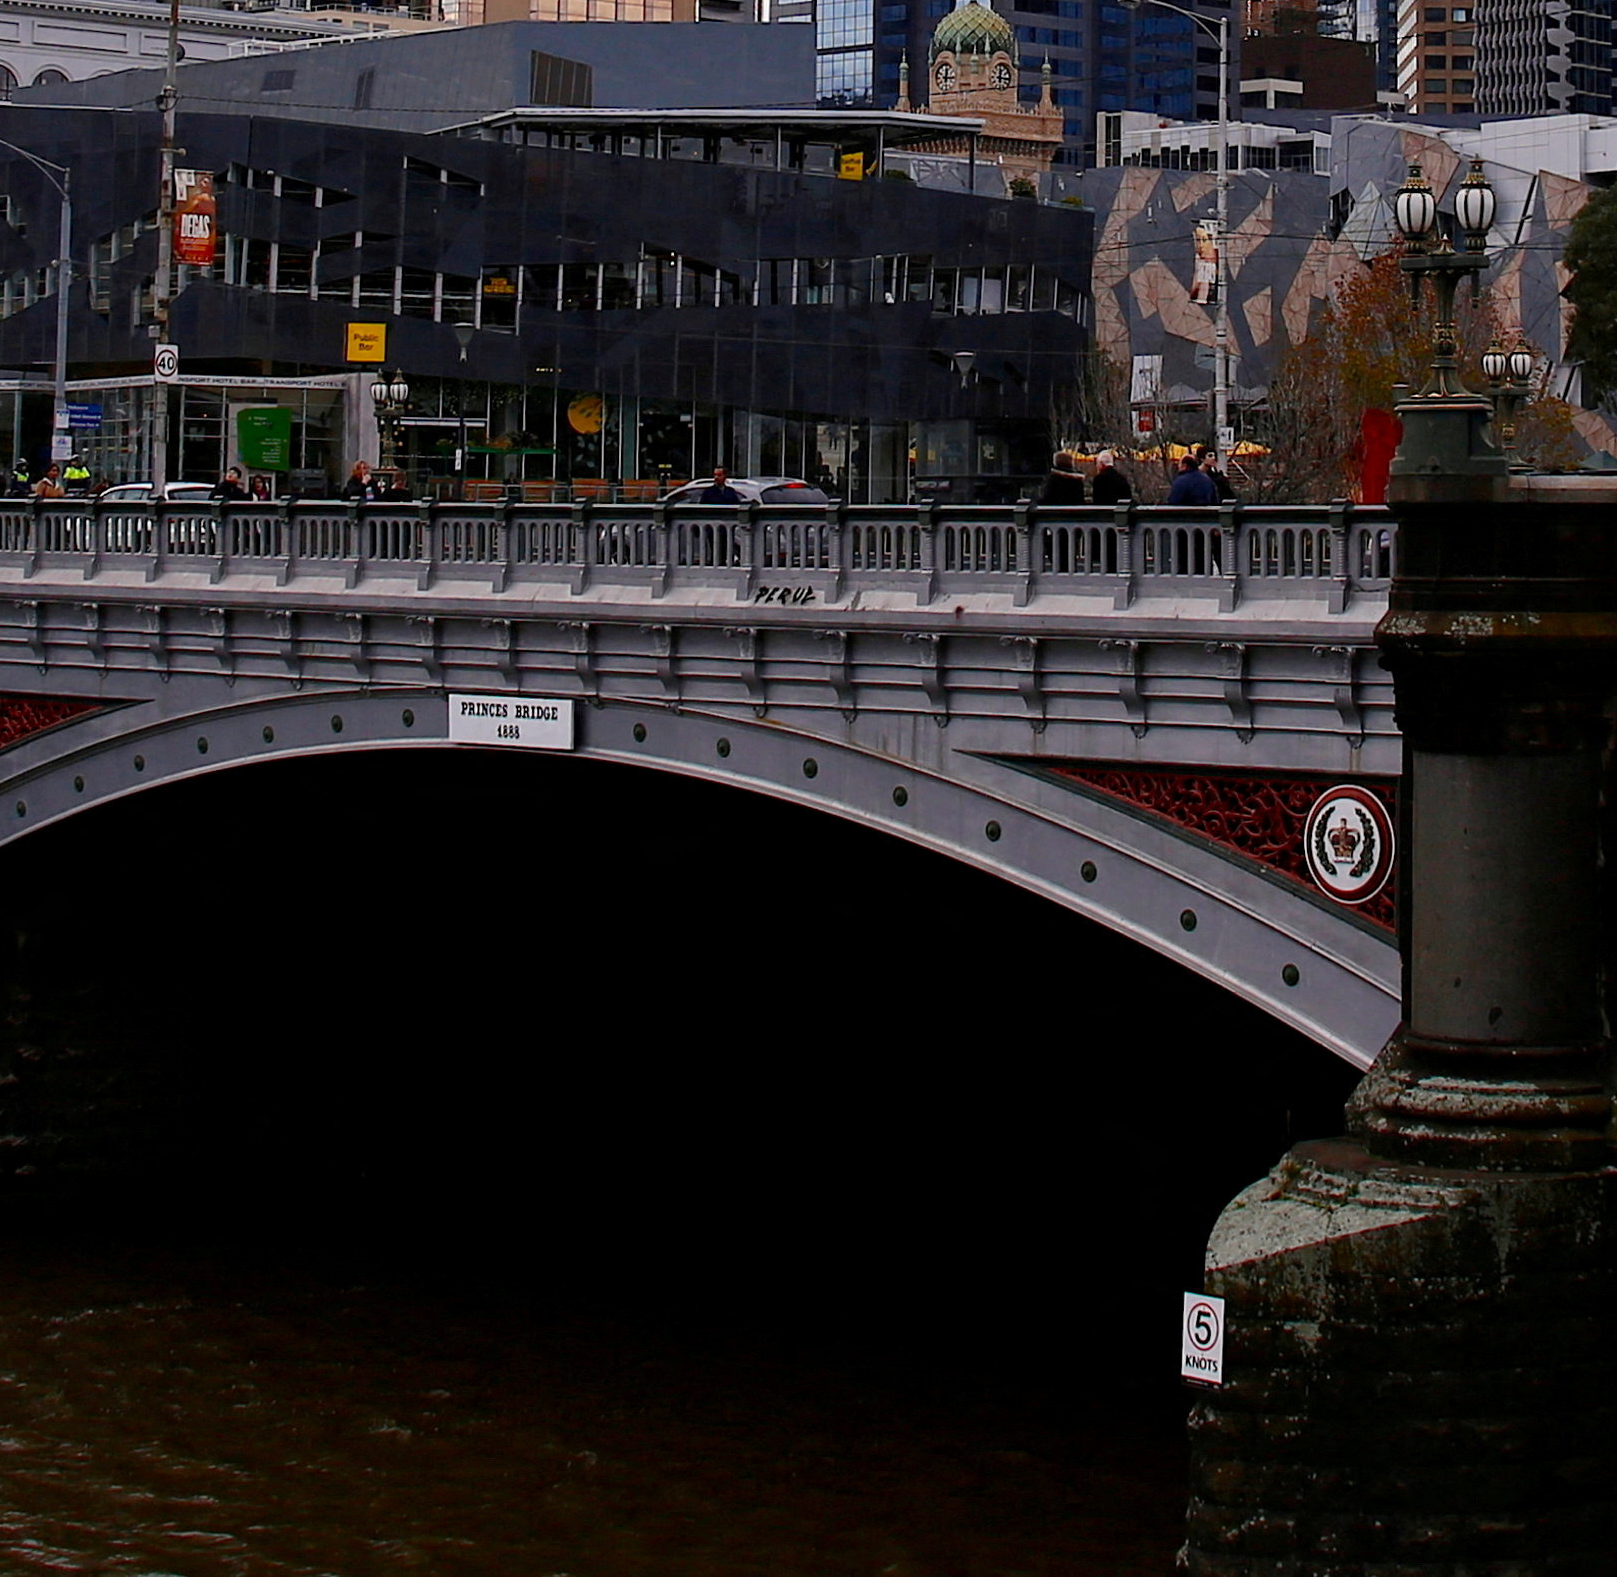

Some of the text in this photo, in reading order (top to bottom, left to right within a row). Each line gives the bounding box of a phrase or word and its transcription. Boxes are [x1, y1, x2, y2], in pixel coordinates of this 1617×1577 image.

[180, 213, 210, 239] DEGAS
[353, 334, 379, 342] Public
[358, 343, 374, 351] Bar
[158, 356, 175, 370] 40
[461, 702, 558, 721] PRINCES BRIDGE
[1194, 1310, 1211, 1345] 5
[1185, 1354, 1219, 1372] KNOTS
